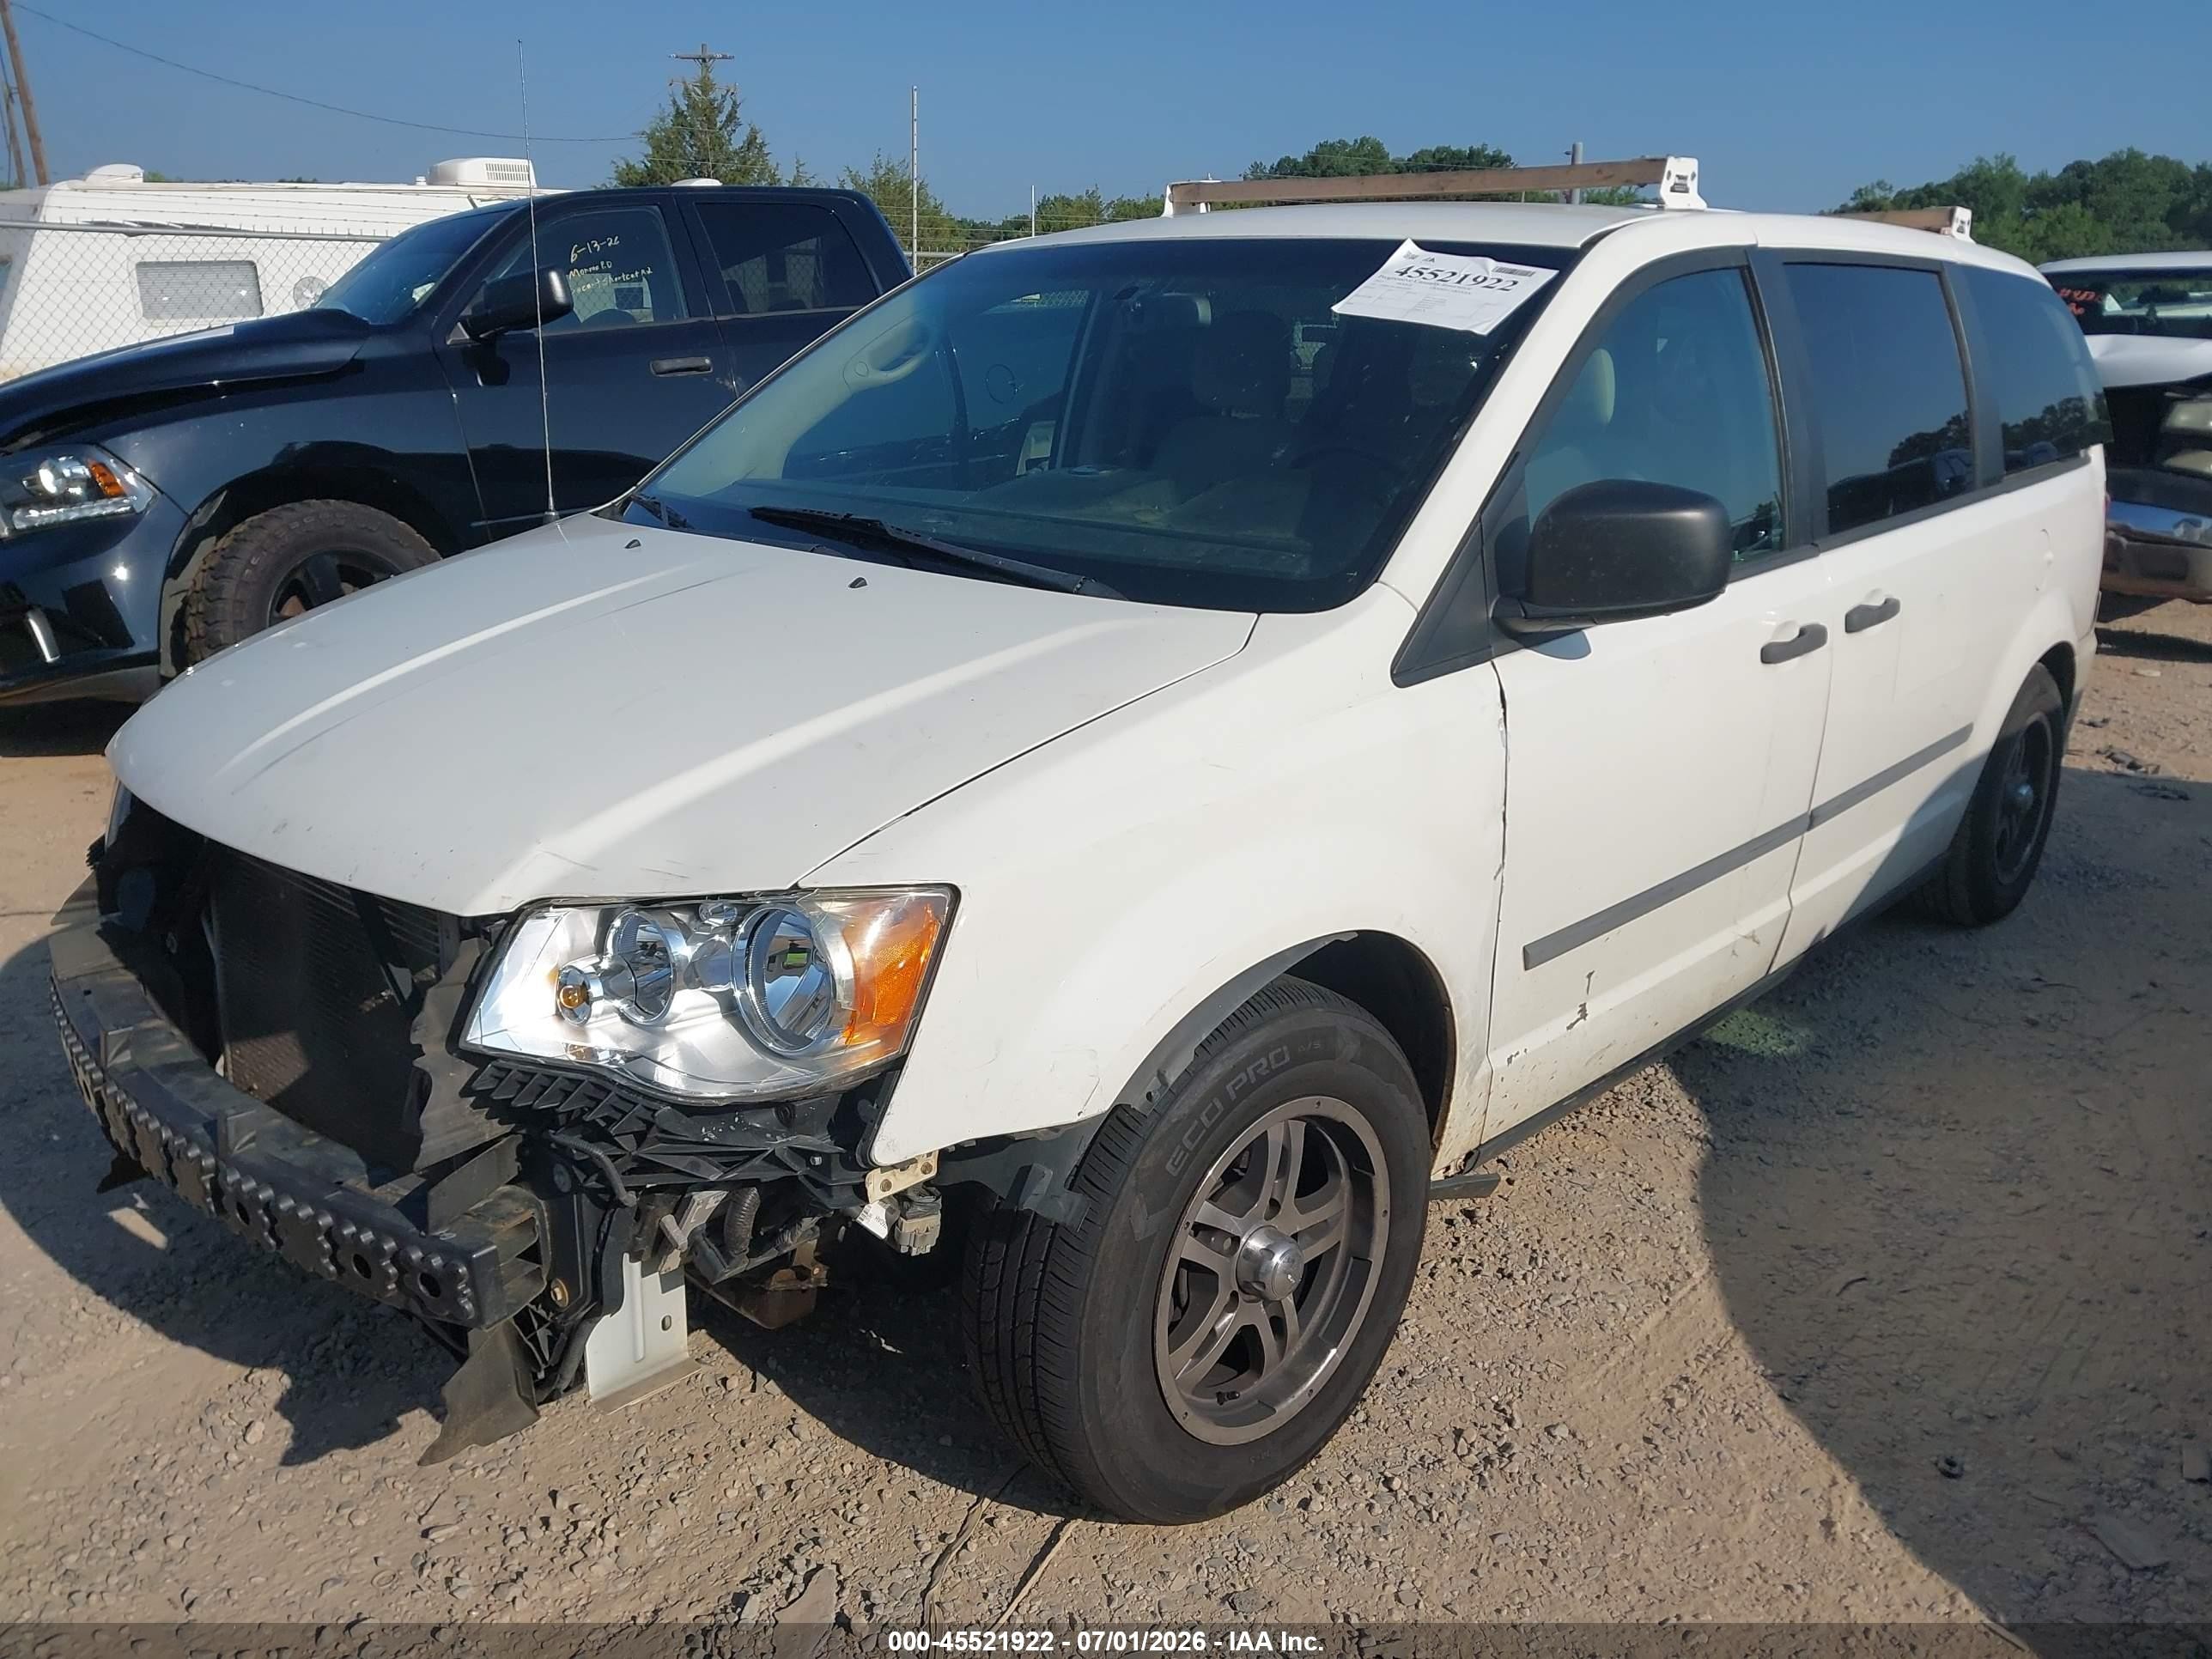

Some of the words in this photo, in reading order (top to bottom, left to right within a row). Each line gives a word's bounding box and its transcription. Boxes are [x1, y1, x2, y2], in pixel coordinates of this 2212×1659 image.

[570, 235, 620, 264] 6-13-26
[1395, 265, 1519, 291] 45521922
[1165, 1097, 1224, 1177] ECO
[1225, 1045, 1291, 1101] PRO
